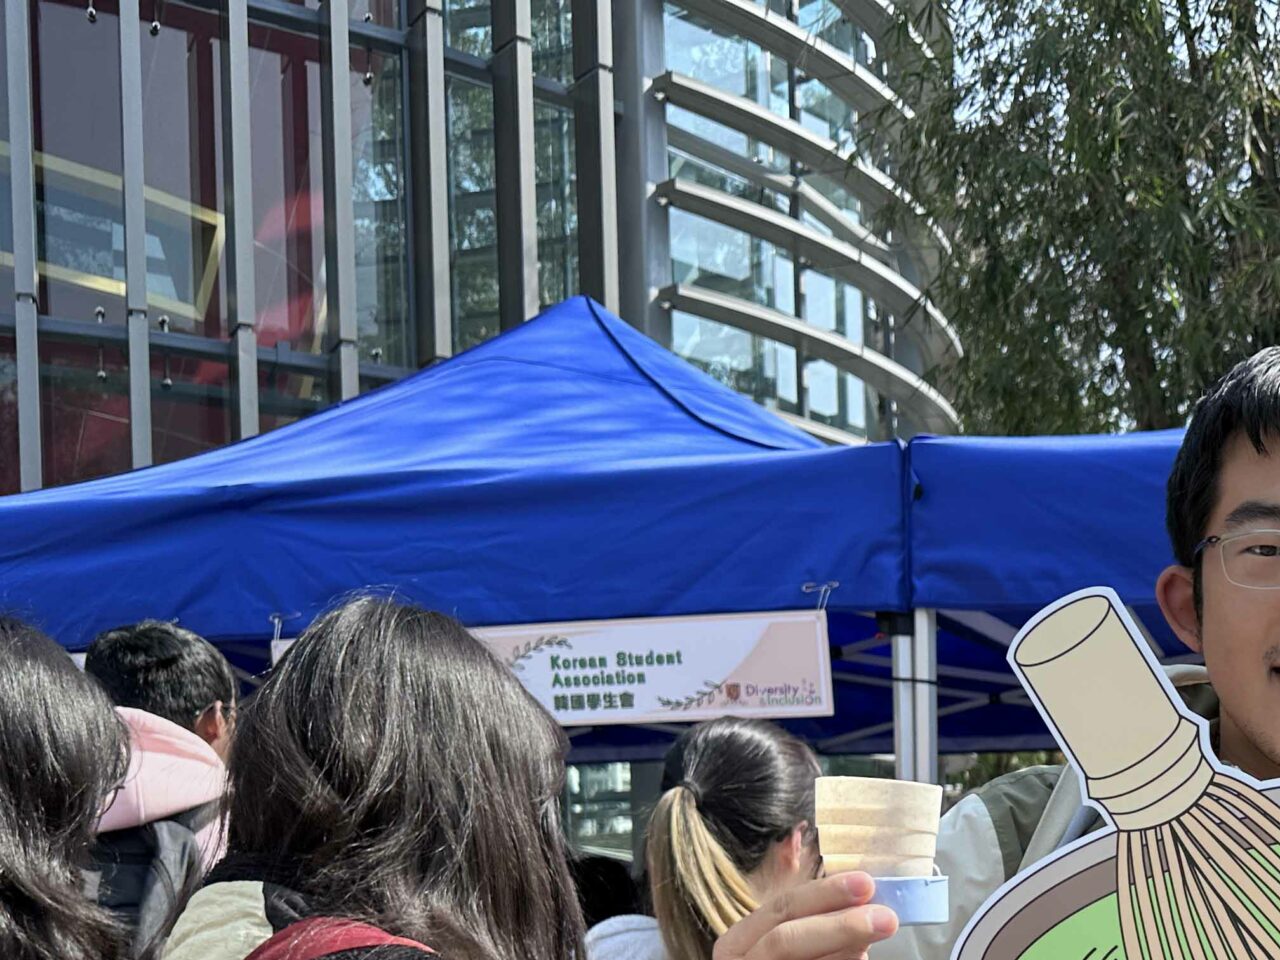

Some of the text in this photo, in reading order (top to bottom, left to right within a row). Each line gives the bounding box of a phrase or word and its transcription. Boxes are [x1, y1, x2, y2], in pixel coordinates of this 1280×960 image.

[550, 650, 683, 671] Korean Student
[552, 670, 646, 688] Association
[746, 683, 799, 697] Diversity
